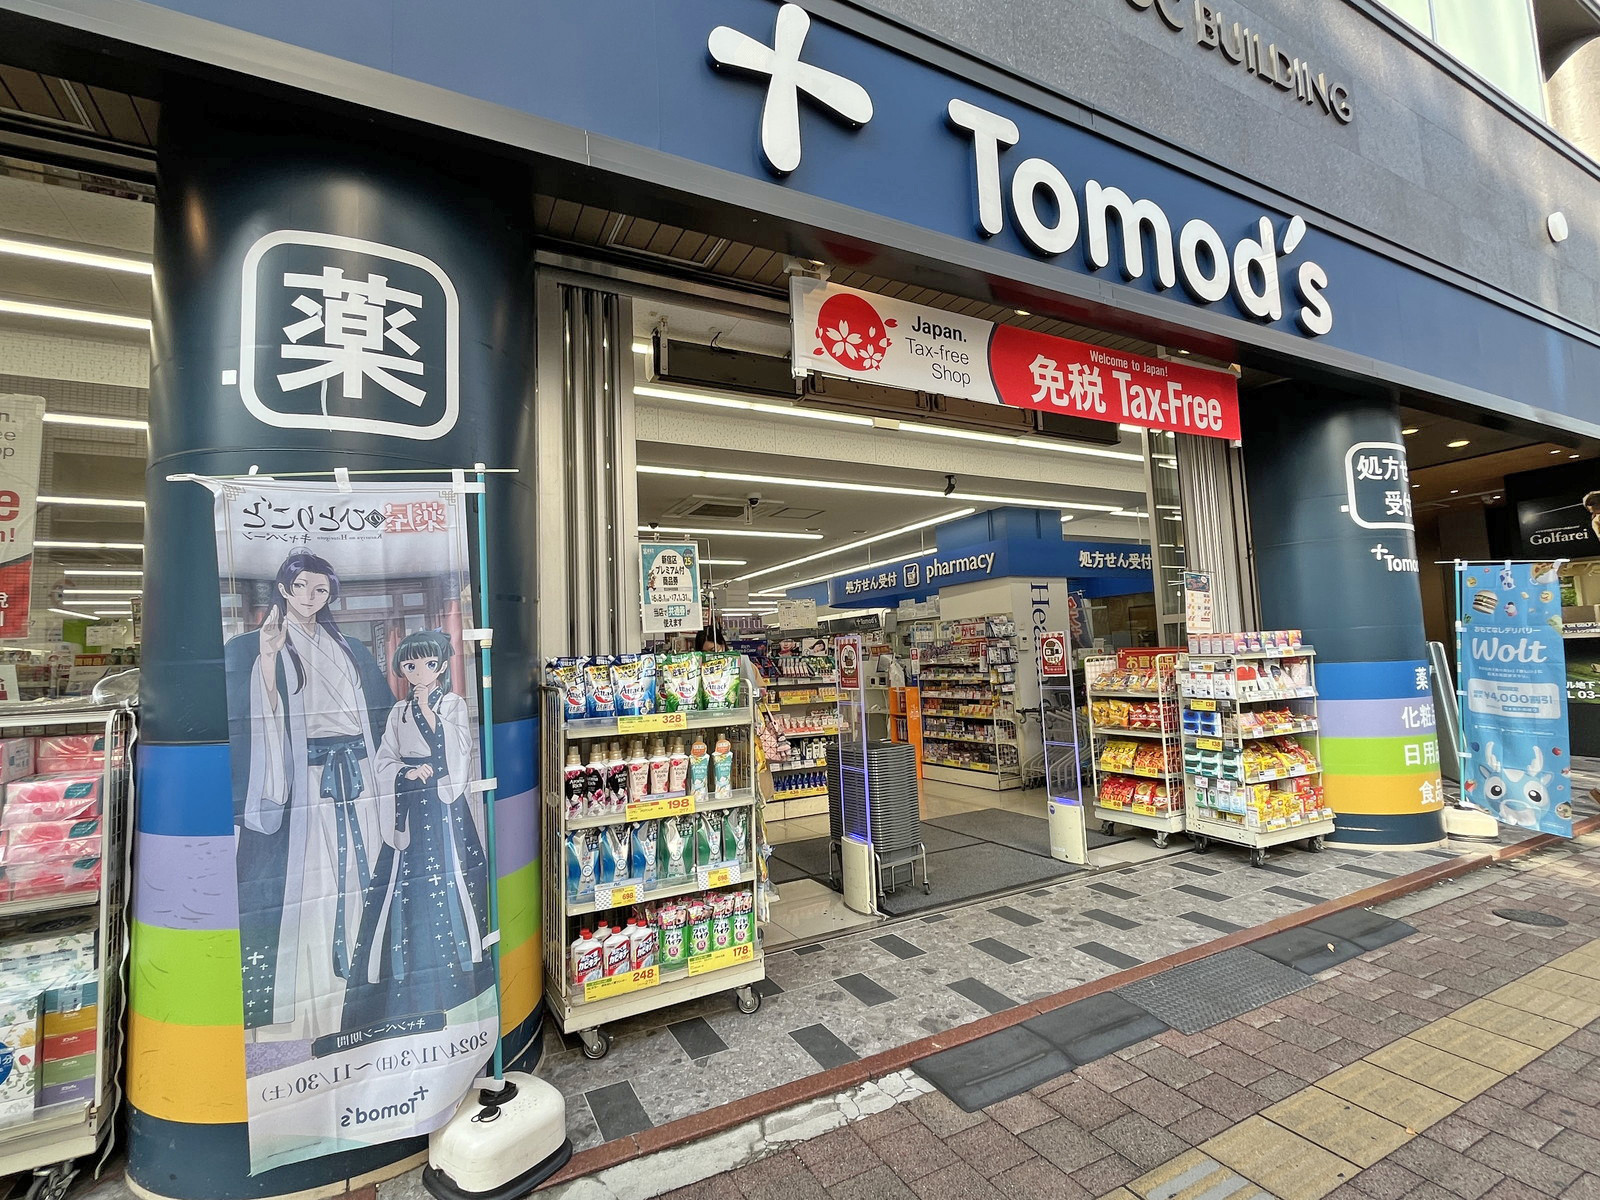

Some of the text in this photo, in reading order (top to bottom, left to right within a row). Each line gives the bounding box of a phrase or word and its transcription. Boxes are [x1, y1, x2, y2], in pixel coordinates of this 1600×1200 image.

[1195, 0, 1354, 124] BUILDING
[945, 97, 1333, 336] Tomod's
[276, 266, 429, 407] 薬
[911, 315, 967, 343] Japan.
[905, 337, 969, 365] Tax-free
[1090, 350, 1168, 377] Welcome to Japan!
[931, 363, 971, 387] Shop
[1028, 353, 1223, 431] 免税 Tax-Free
[1529, 528, 1590, 546] Golfarei
[926, 552, 996, 584] pharmacy
[1079, 550, 1153, 570] 処方せん受付
[845, 570, 898, 595] 処方せん受付
[1471, 637, 1548, 663] Wolt
[1414, 667, 1429, 691] 薬
[662, 714, 682, 724] 328
[667, 799, 690, 810] 198
[733, 945, 749, 957] 178
[632, 968, 654, 982] 248
